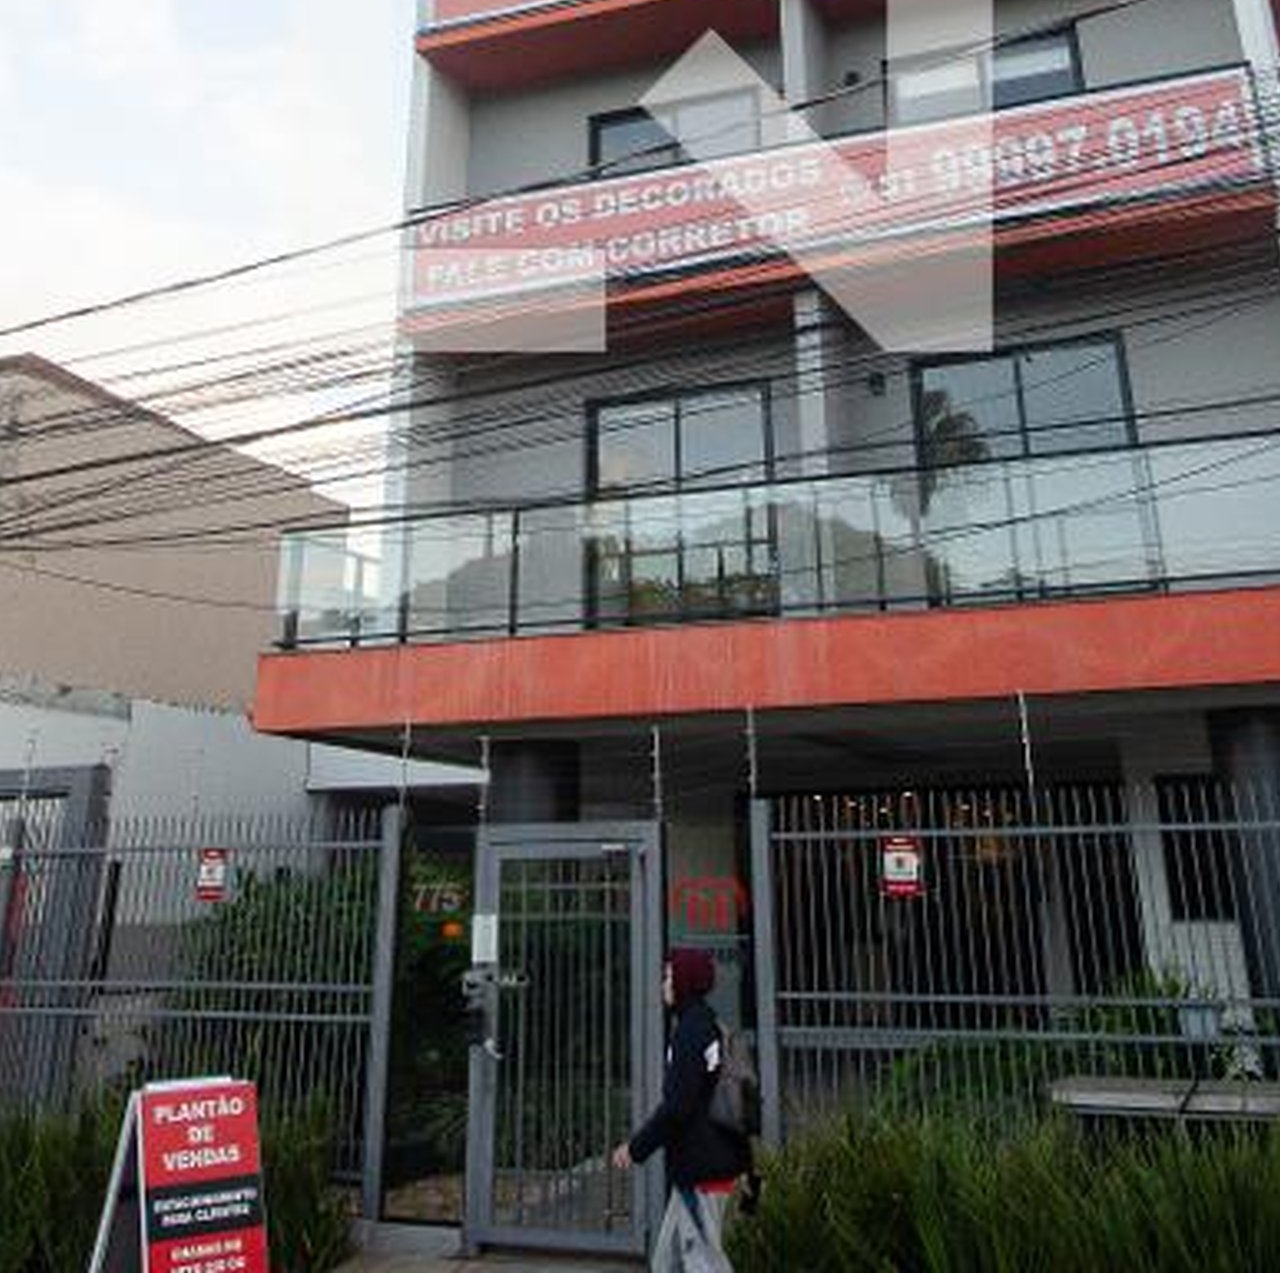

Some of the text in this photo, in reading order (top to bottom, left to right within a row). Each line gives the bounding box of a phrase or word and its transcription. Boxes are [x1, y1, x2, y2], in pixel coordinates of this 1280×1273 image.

[420, 159, 821, 245] VISITE OS DECORADOS
[606, 210, 809, 263] CORRETOR
[151, 1097, 246, 1125] PLANTÃO
[187, 1124, 214, 1143] DE
[162, 1144, 241, 1172] VENDAS
